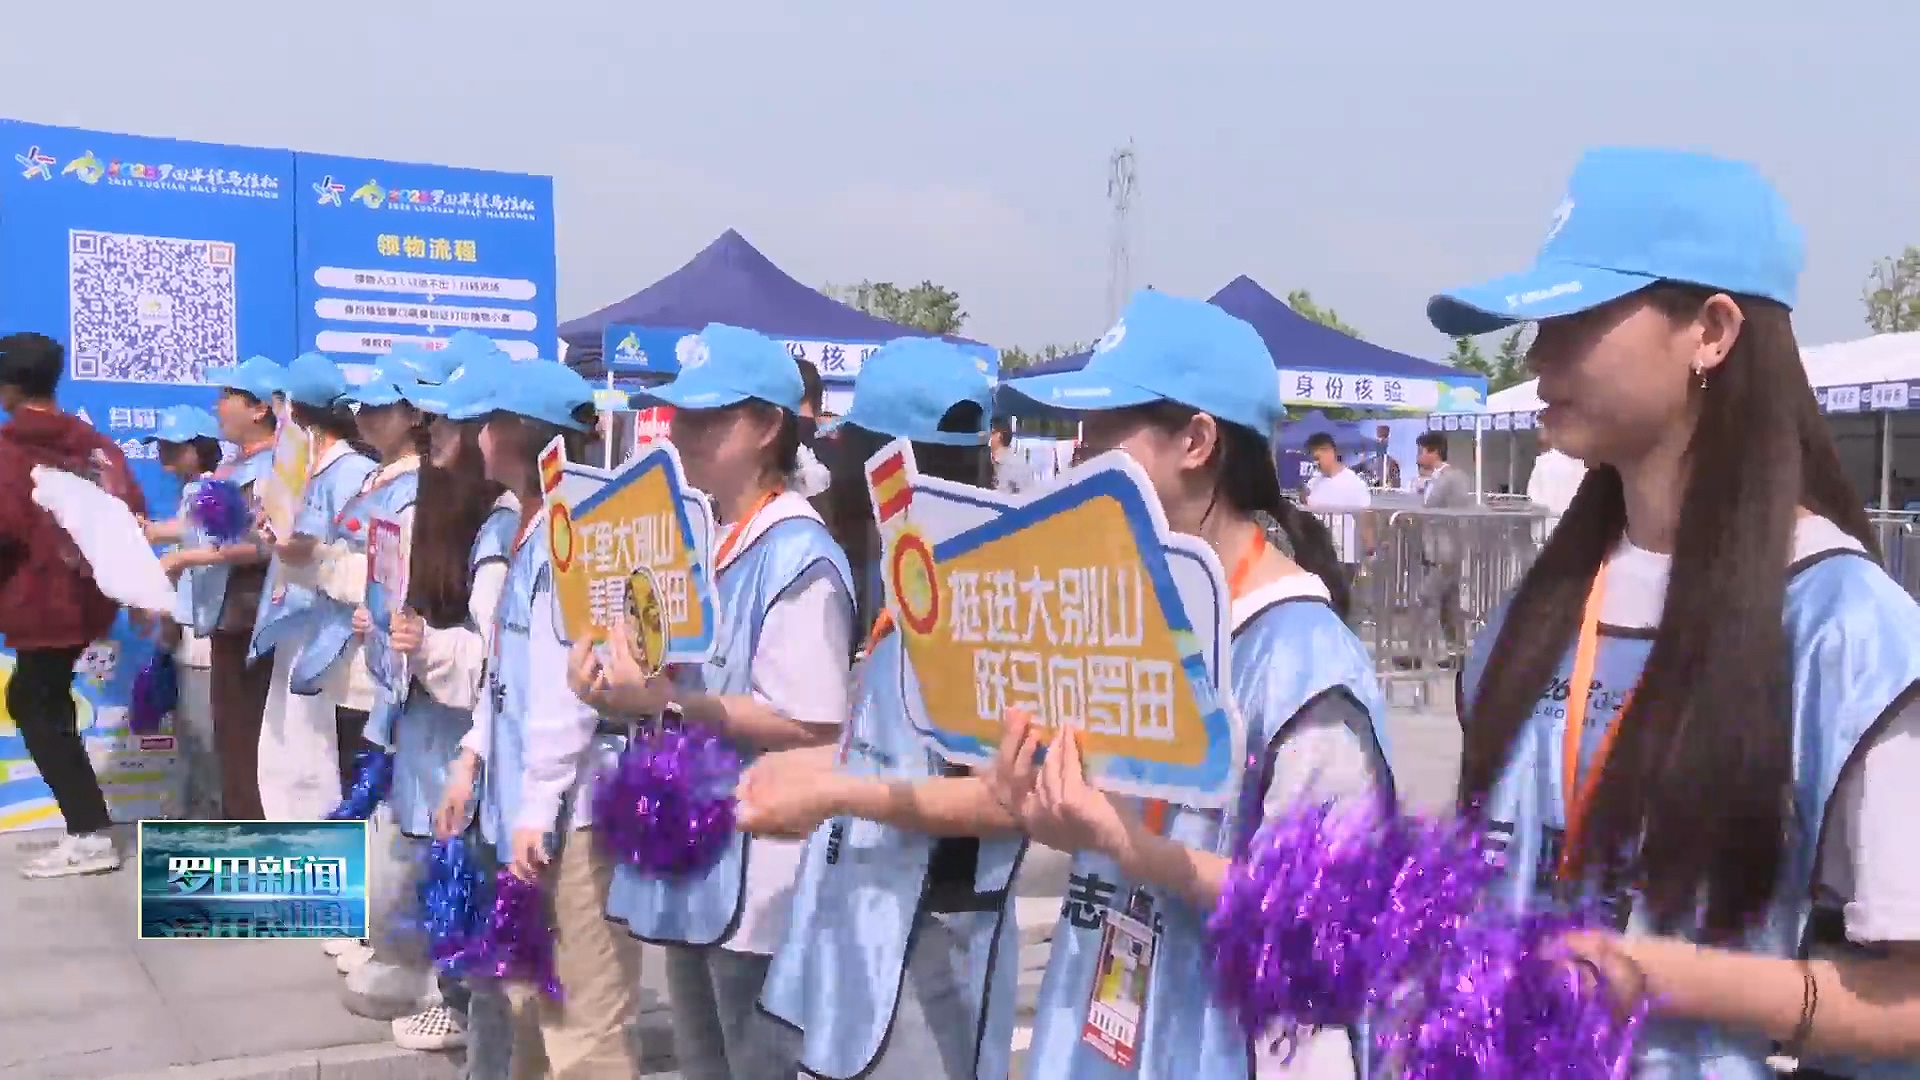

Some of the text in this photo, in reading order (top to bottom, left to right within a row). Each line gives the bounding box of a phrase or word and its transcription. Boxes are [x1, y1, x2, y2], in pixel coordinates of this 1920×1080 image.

[377, 234, 477, 262] 领物流程
[1296, 374, 1405, 402] 身份核验
[577, 511, 677, 573] 千里大别山
[948, 565, 1145, 647] 挺进大别山
[974, 648, 1175, 741] 跃马向罗田
